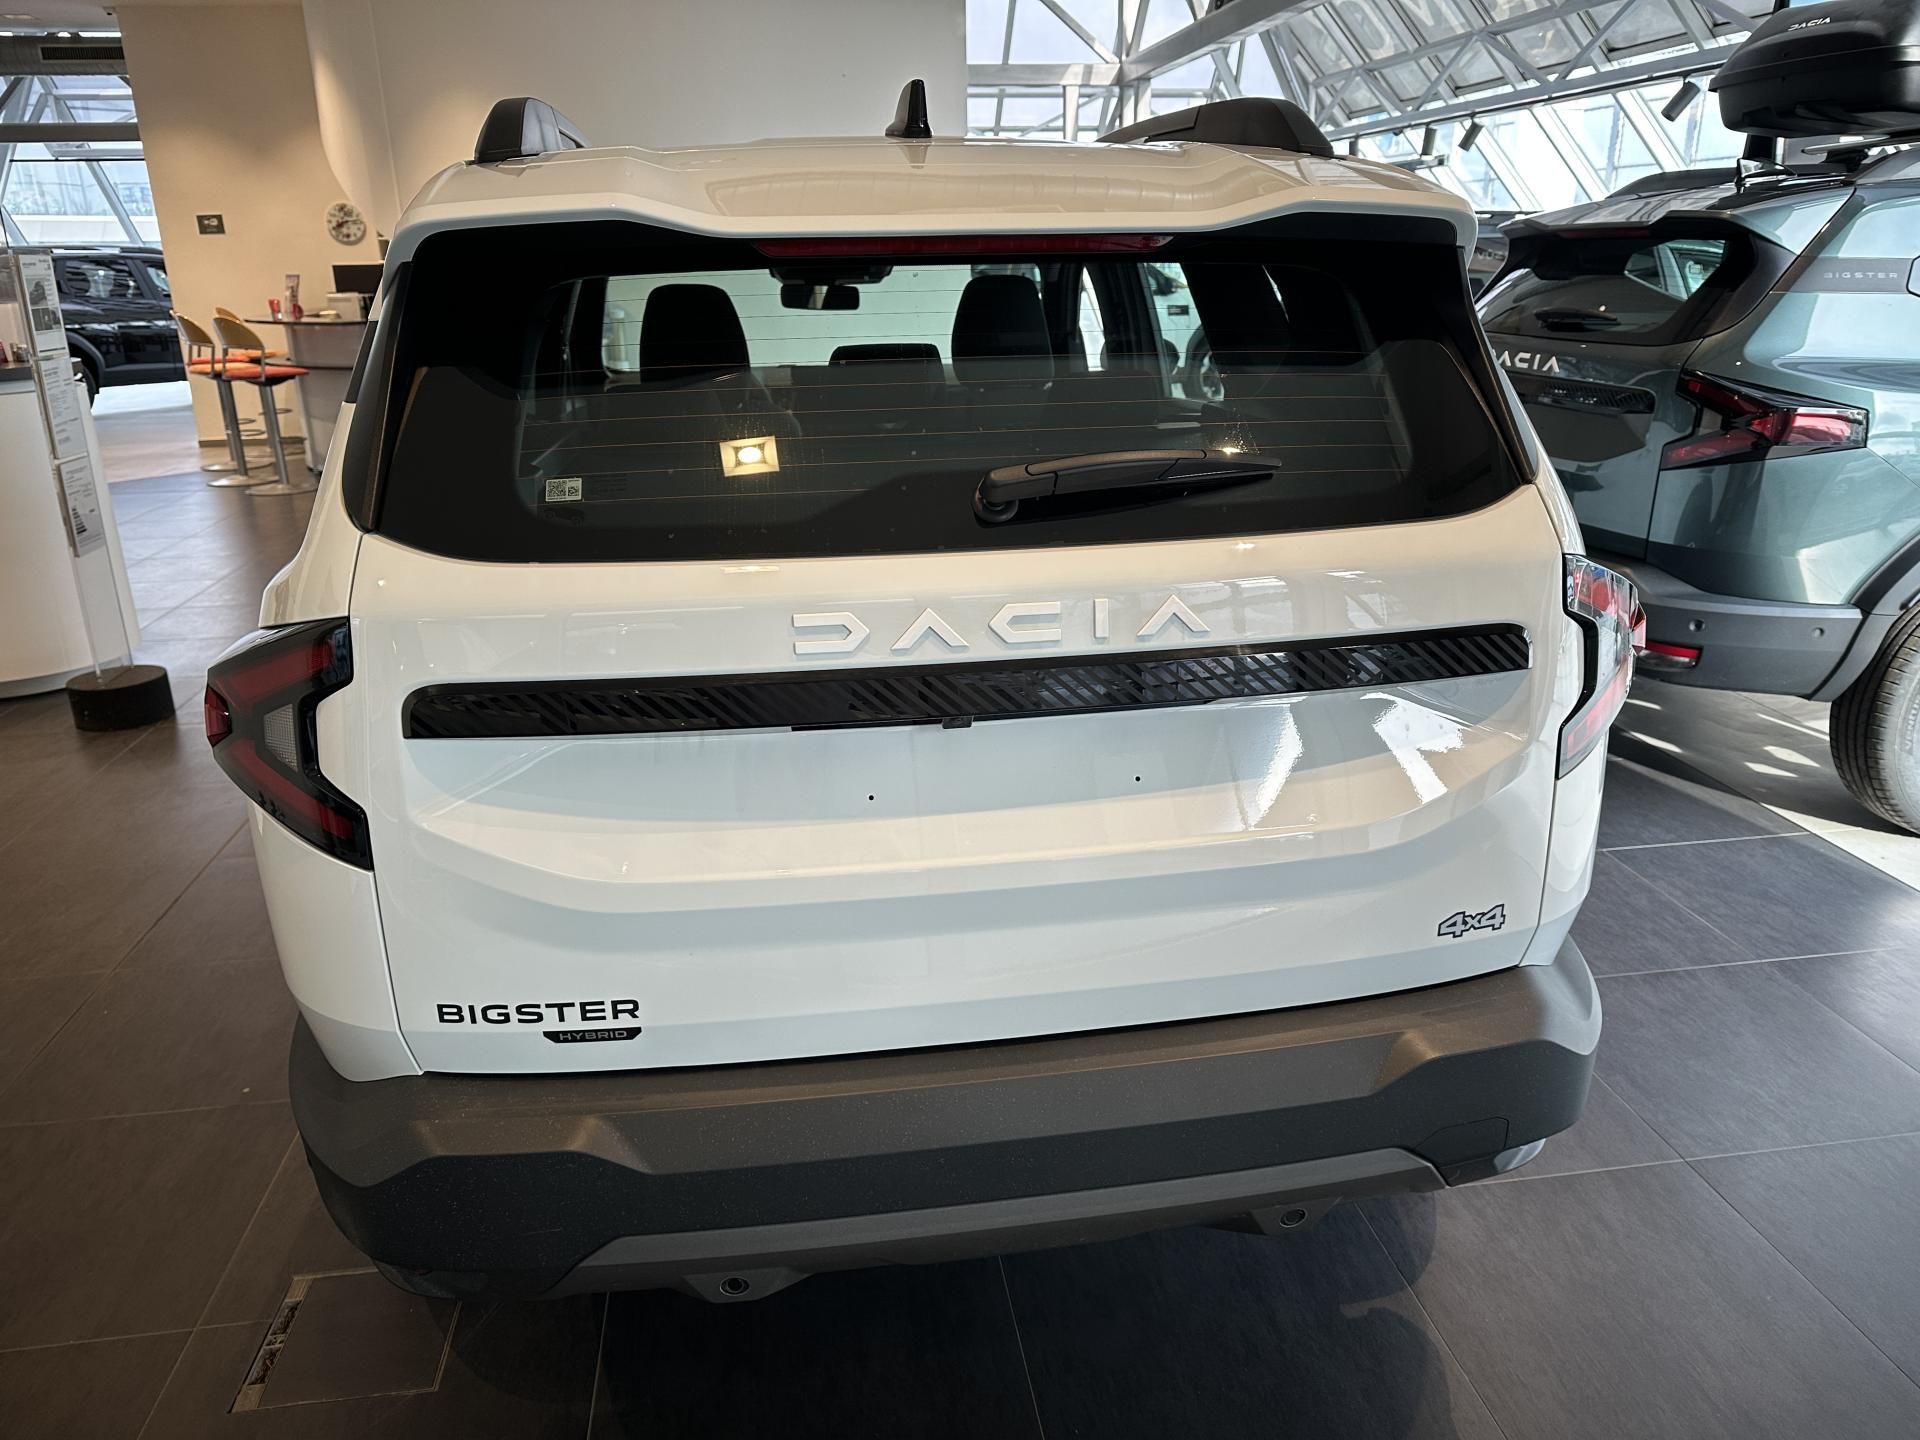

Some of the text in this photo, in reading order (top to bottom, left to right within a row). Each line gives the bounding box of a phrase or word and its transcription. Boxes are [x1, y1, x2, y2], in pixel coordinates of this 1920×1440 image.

[1787, 16, 1831, 31] DACIA
[1823, 271, 1899, 279] BIGSTER
[1492, 349, 1560, 373] ACIA
[792, 593, 1211, 655] DACIA
[1437, 903, 1506, 938] 4x4
[436, 999, 640, 1025] BIGSTER
[559, 1029, 628, 1042] HYBRID
